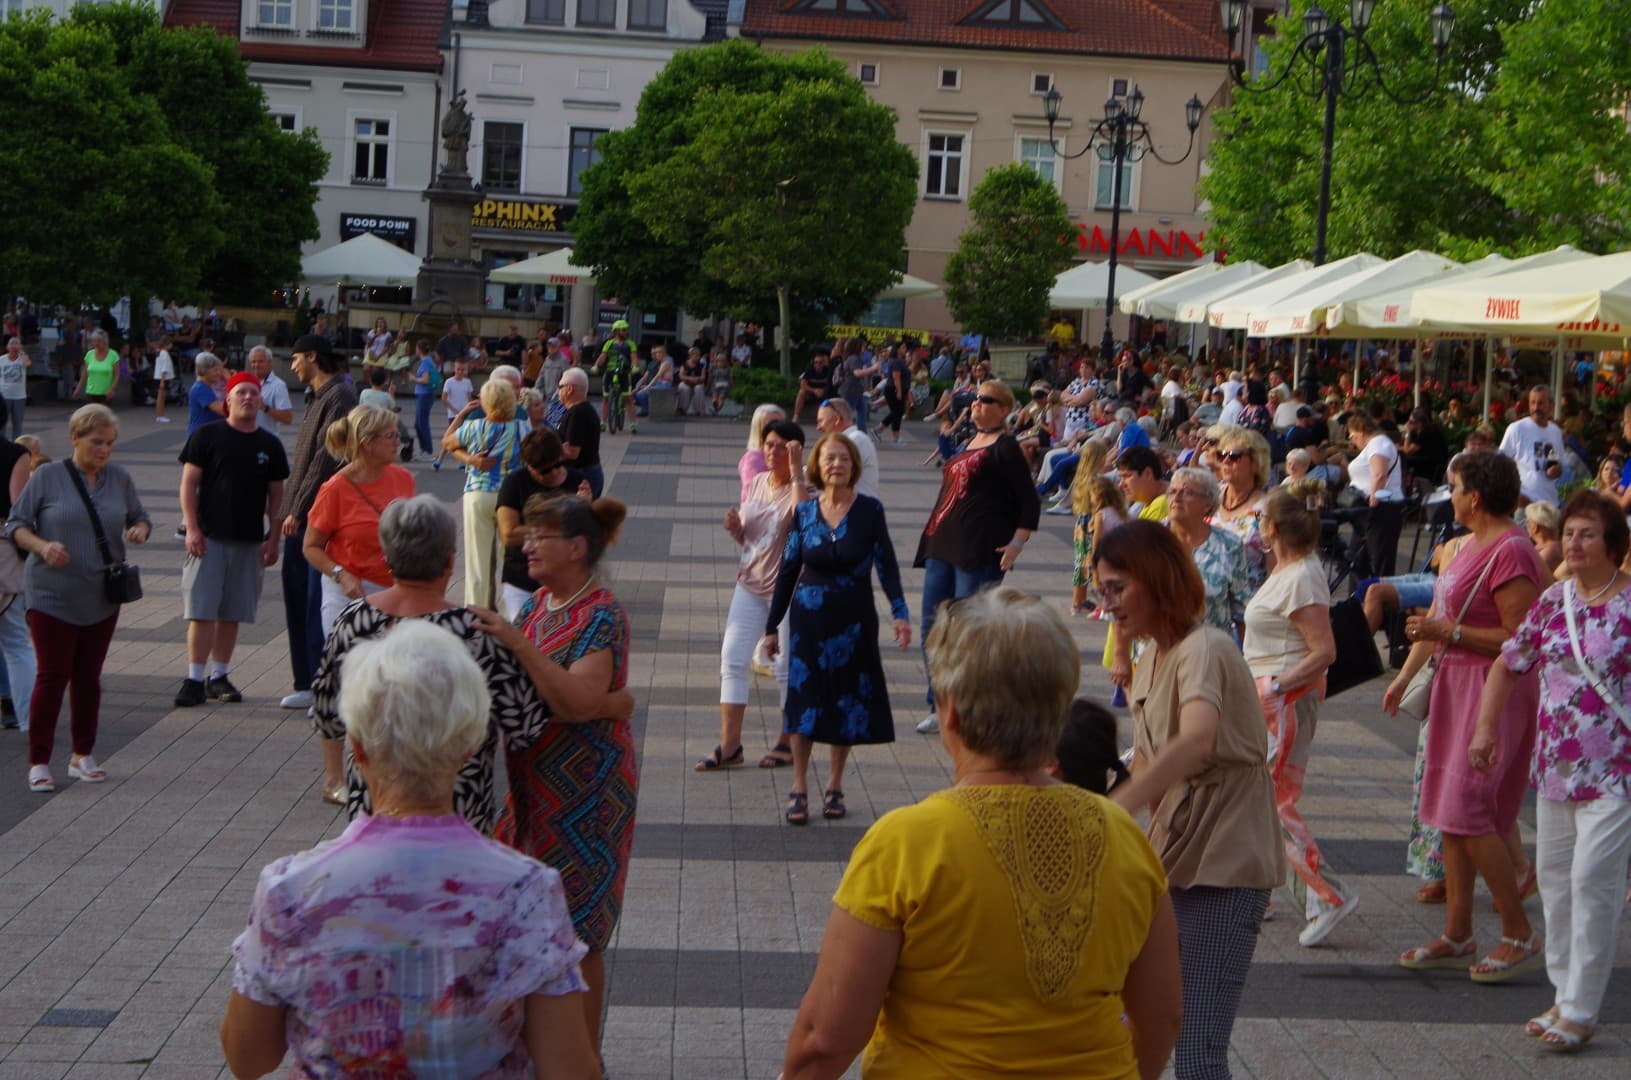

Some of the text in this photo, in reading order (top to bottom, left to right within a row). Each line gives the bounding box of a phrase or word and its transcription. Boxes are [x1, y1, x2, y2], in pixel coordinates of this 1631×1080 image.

[473, 200, 557, 222] SPHINX
[346, 217, 377, 228] FOOD
[472, 218, 557, 232] RESTAURACJA
